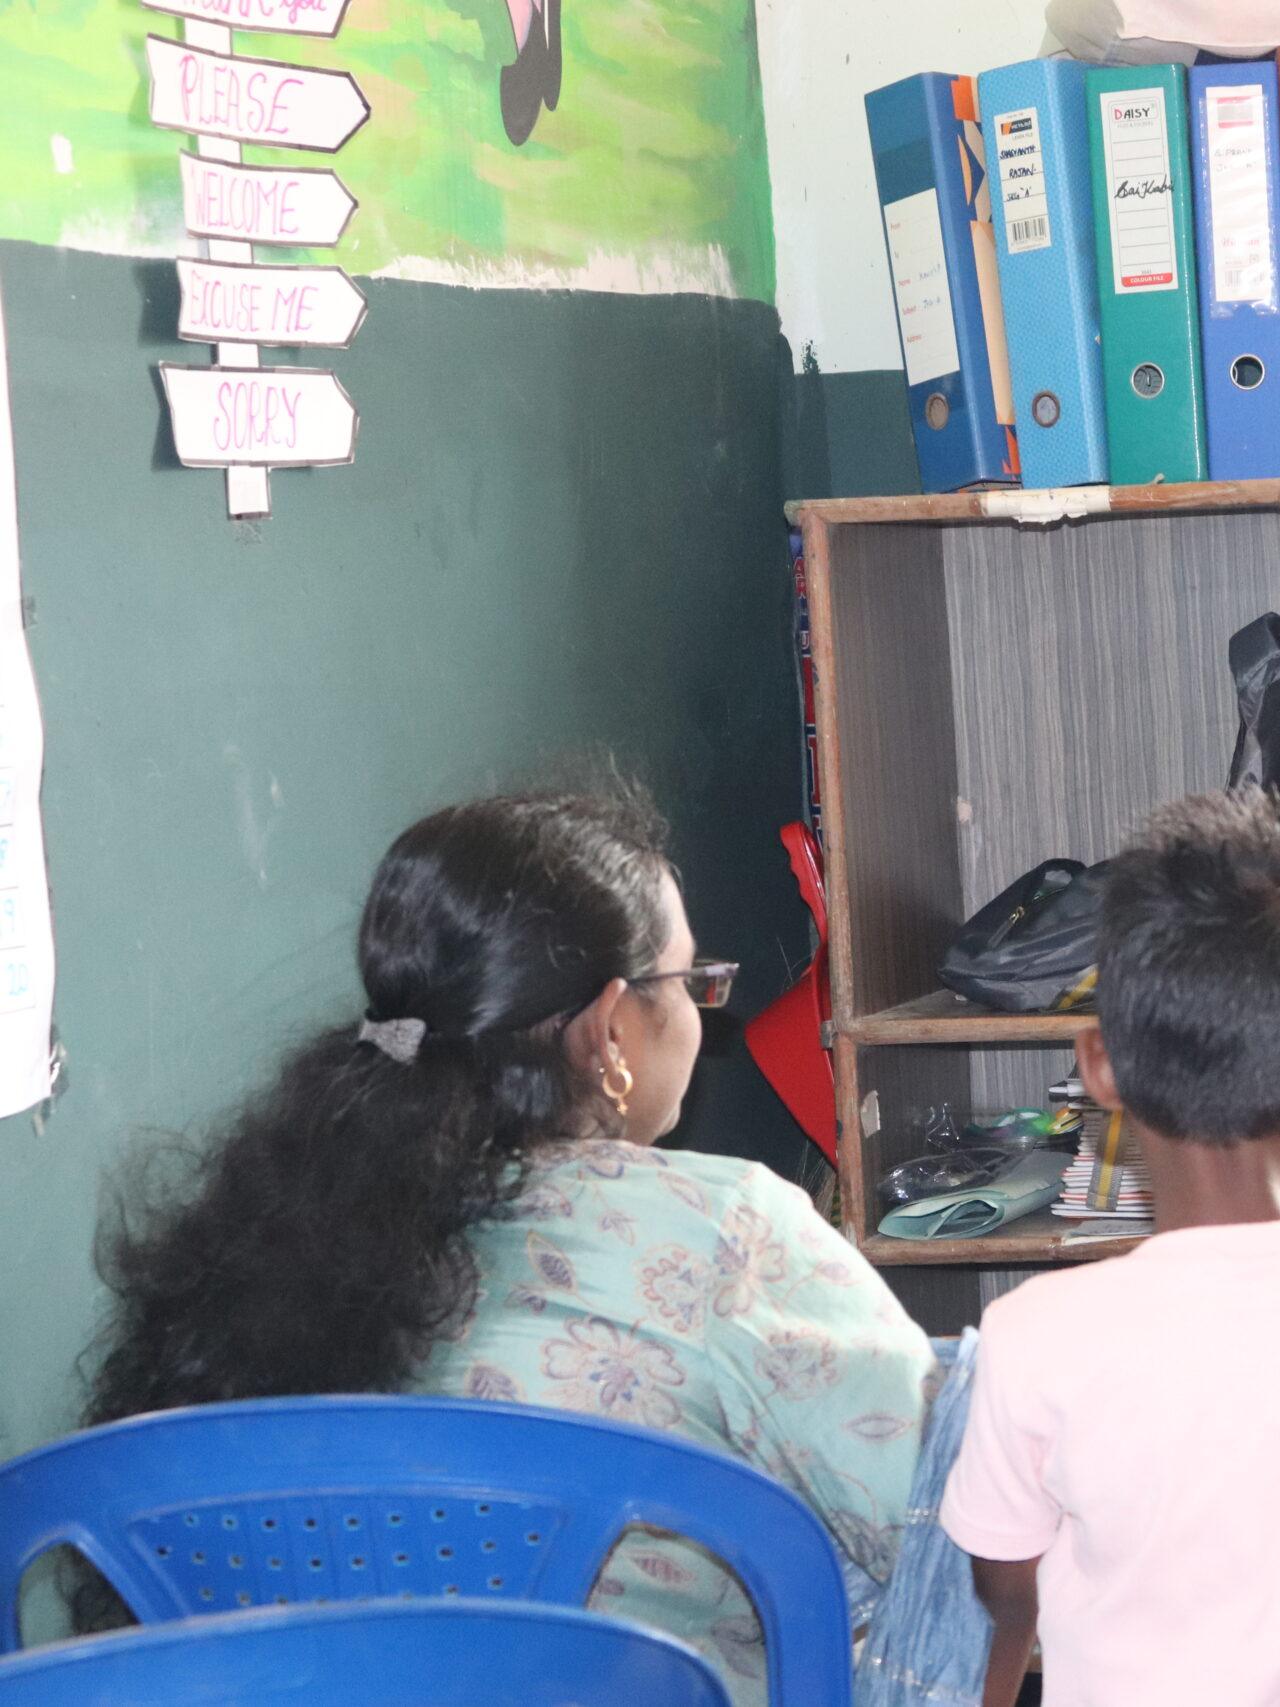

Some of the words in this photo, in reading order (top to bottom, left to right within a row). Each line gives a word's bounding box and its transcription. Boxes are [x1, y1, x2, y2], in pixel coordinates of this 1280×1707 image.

[180, 55, 304, 135] PLEASE
[1114, 107, 1150, 120] DAISY
[191, 164, 300, 235] WELCOME
[190, 269, 262, 332] EXCUSE
[271, 286, 319, 333] ME
[213, 381, 302, 451] SORRY
